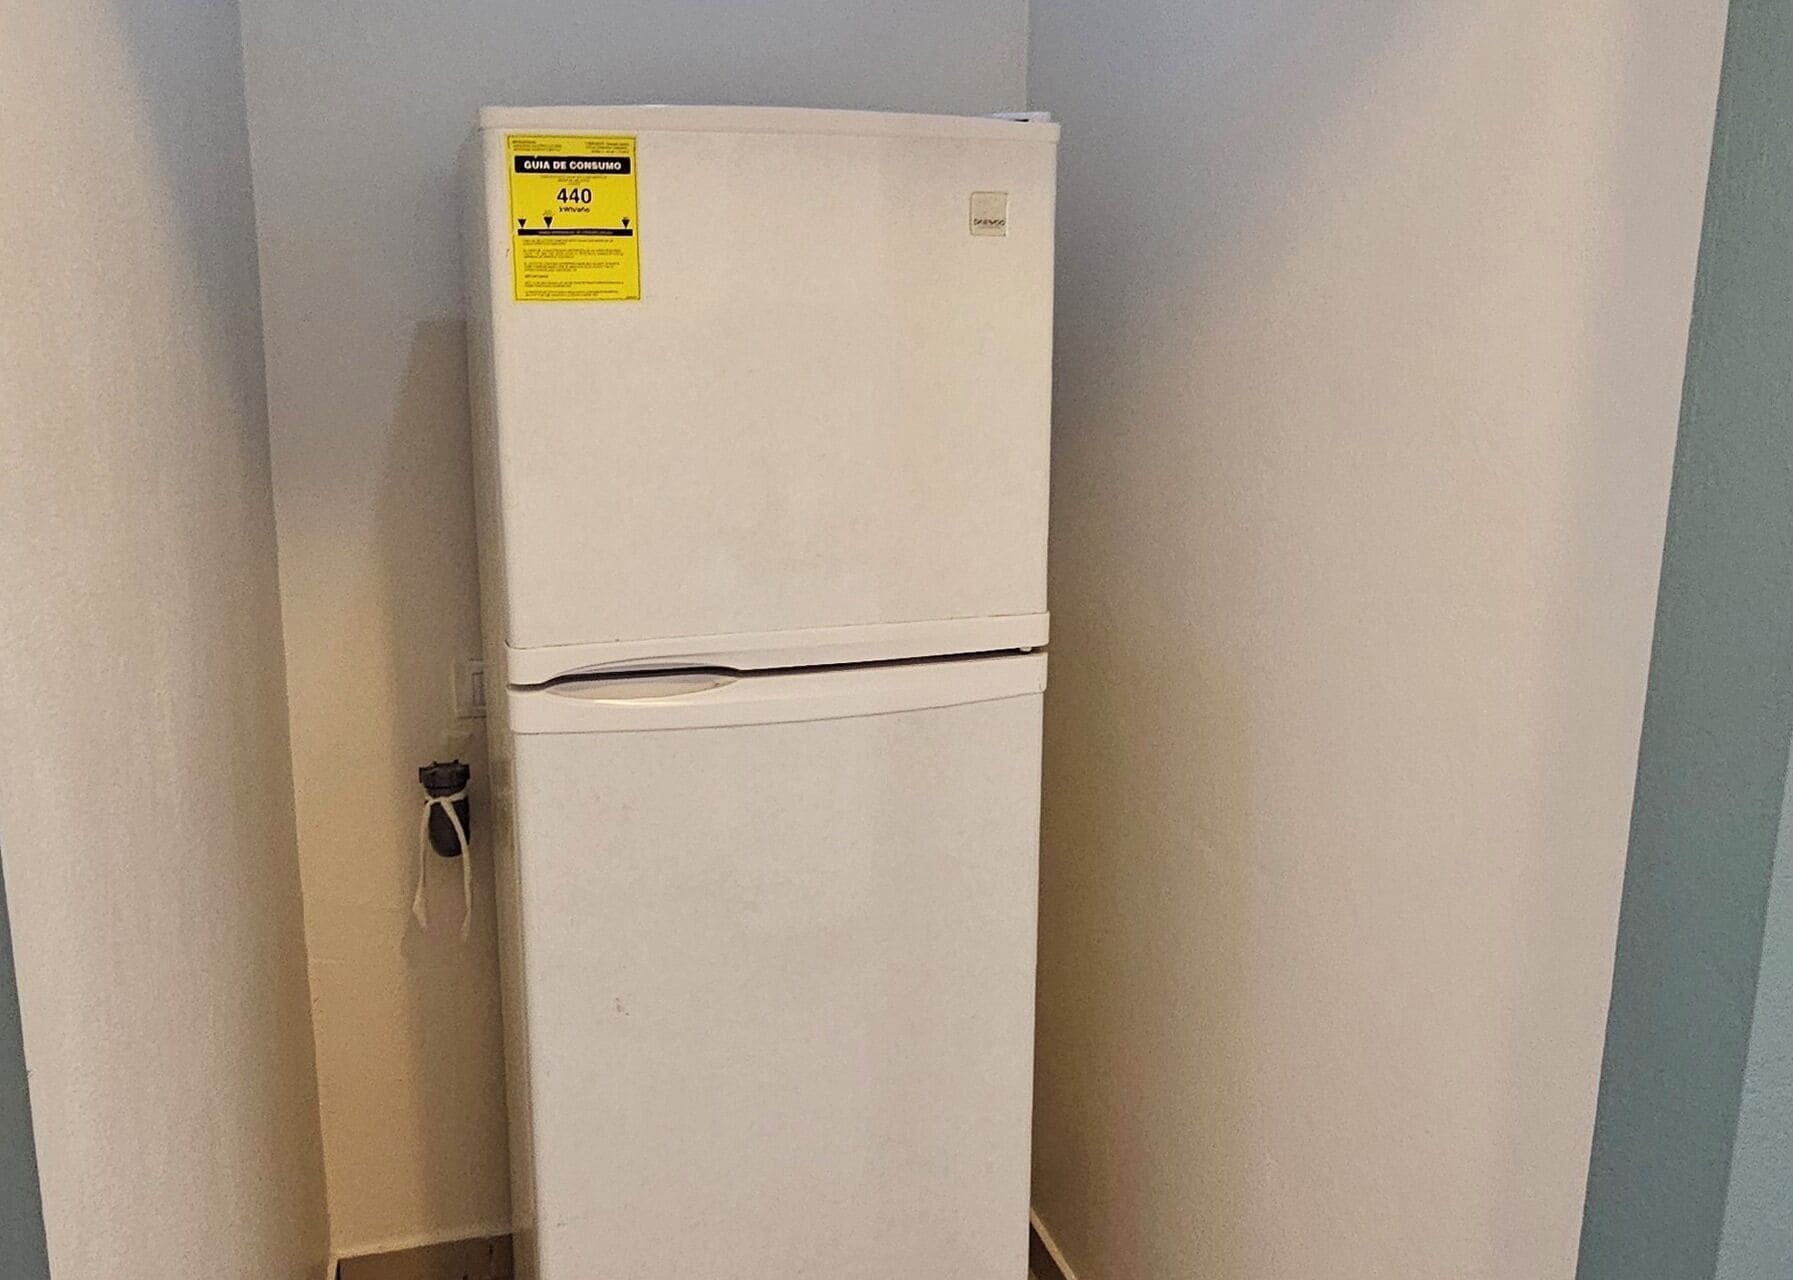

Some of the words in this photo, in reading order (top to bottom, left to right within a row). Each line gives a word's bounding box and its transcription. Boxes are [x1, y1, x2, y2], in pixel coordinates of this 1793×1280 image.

[553, 161, 567, 170] DE
[569, 161, 622, 170] CONSUMO
[557, 188, 592, 204] 440
